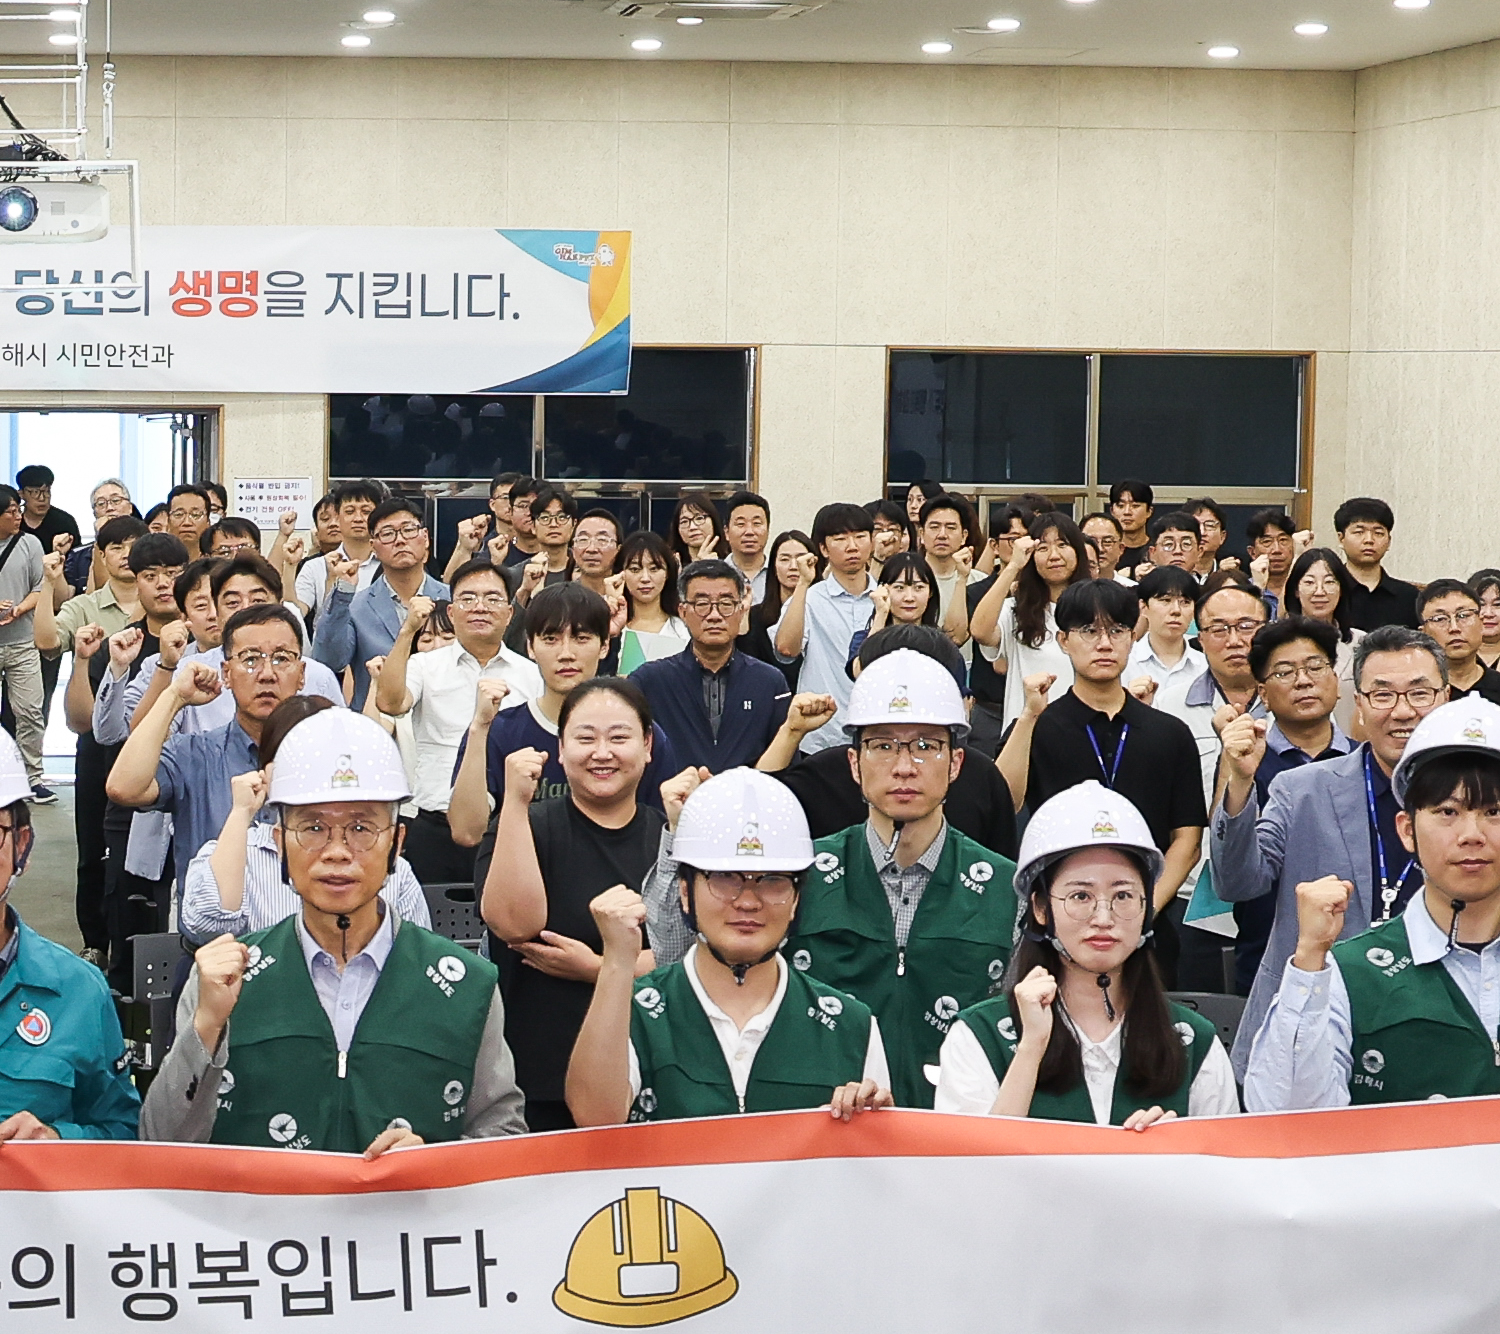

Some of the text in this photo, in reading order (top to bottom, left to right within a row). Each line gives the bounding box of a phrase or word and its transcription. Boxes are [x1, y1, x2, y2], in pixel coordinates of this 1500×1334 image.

[15, 269, 150, 317] 당신의
[168, 269, 307, 319] 생명을
[324, 271, 521, 321] 지킵니다.
[56, 343, 174, 369] 시민안전과
[107, 1230, 519, 1322] 행복입니다.
